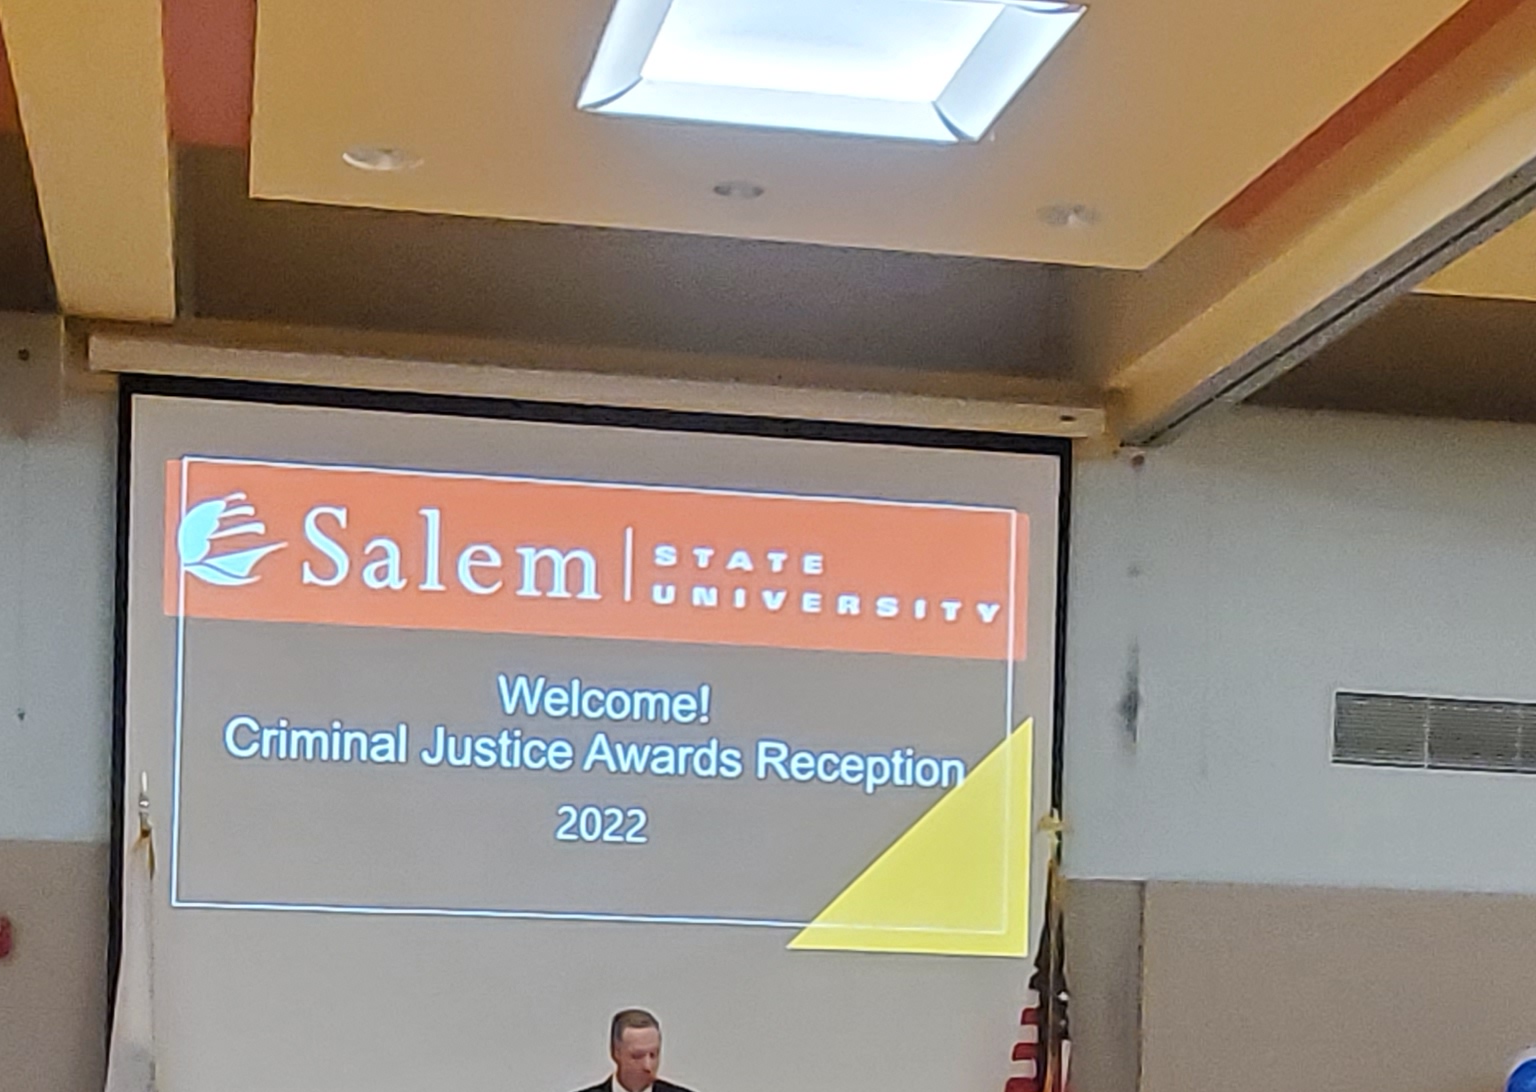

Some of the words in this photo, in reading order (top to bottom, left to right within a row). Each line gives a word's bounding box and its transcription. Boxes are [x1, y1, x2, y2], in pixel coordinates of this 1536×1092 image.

[302, 505, 602, 601] Salem
[653, 544, 824, 575] STATE
[651, 583, 1001, 624] UNIVERSITY
[497, 673, 711, 723] Welcome!
[224, 715, 408, 763] Criminal
[420, 724, 575, 771] Justice
[582, 732, 743, 779] Awards
[756, 739, 966, 795] Reception
[555, 804, 648, 844] 2022
